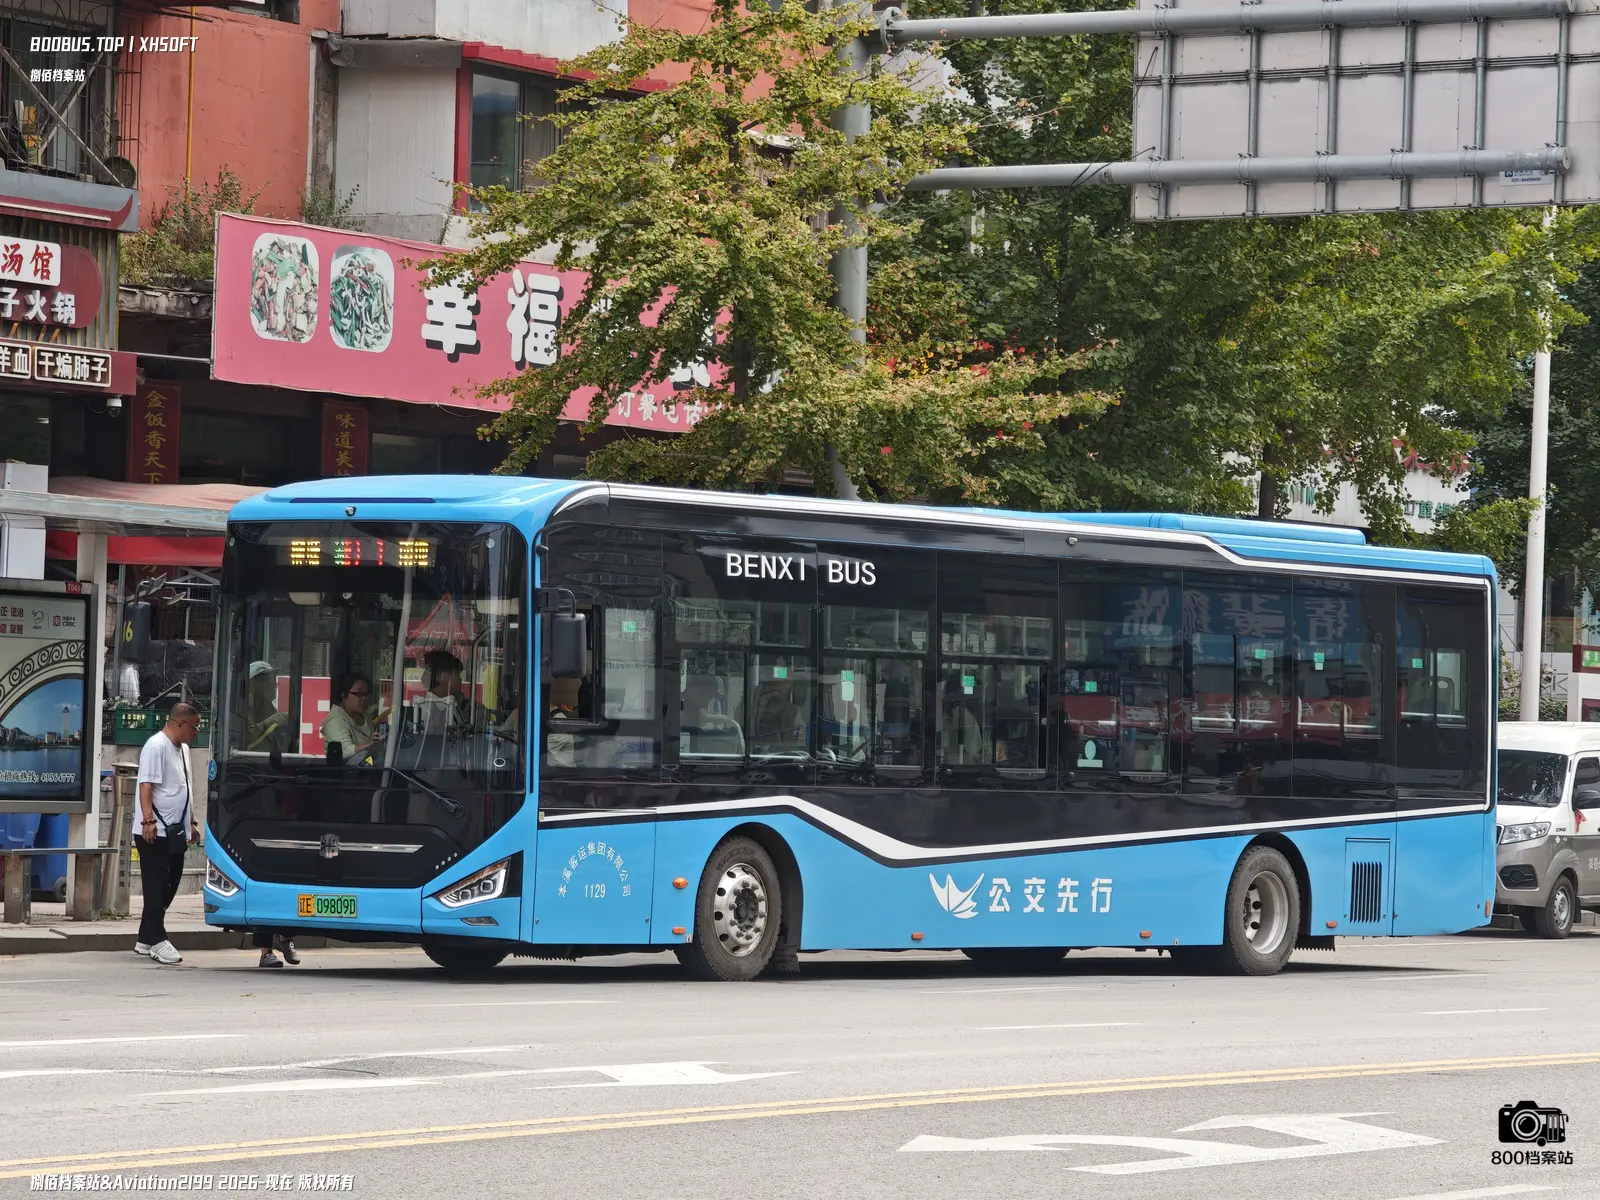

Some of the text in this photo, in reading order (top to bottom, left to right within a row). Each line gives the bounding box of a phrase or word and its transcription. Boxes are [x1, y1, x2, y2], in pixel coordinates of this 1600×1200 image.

[1, 243, 54, 281] 汤馆
[143, 390, 168, 485] 盒饭香天下
[726, 553, 877, 585] BENXI BUS
[584, 883, 606, 898] 1129
[989, 876, 1113, 913] 公交先行
